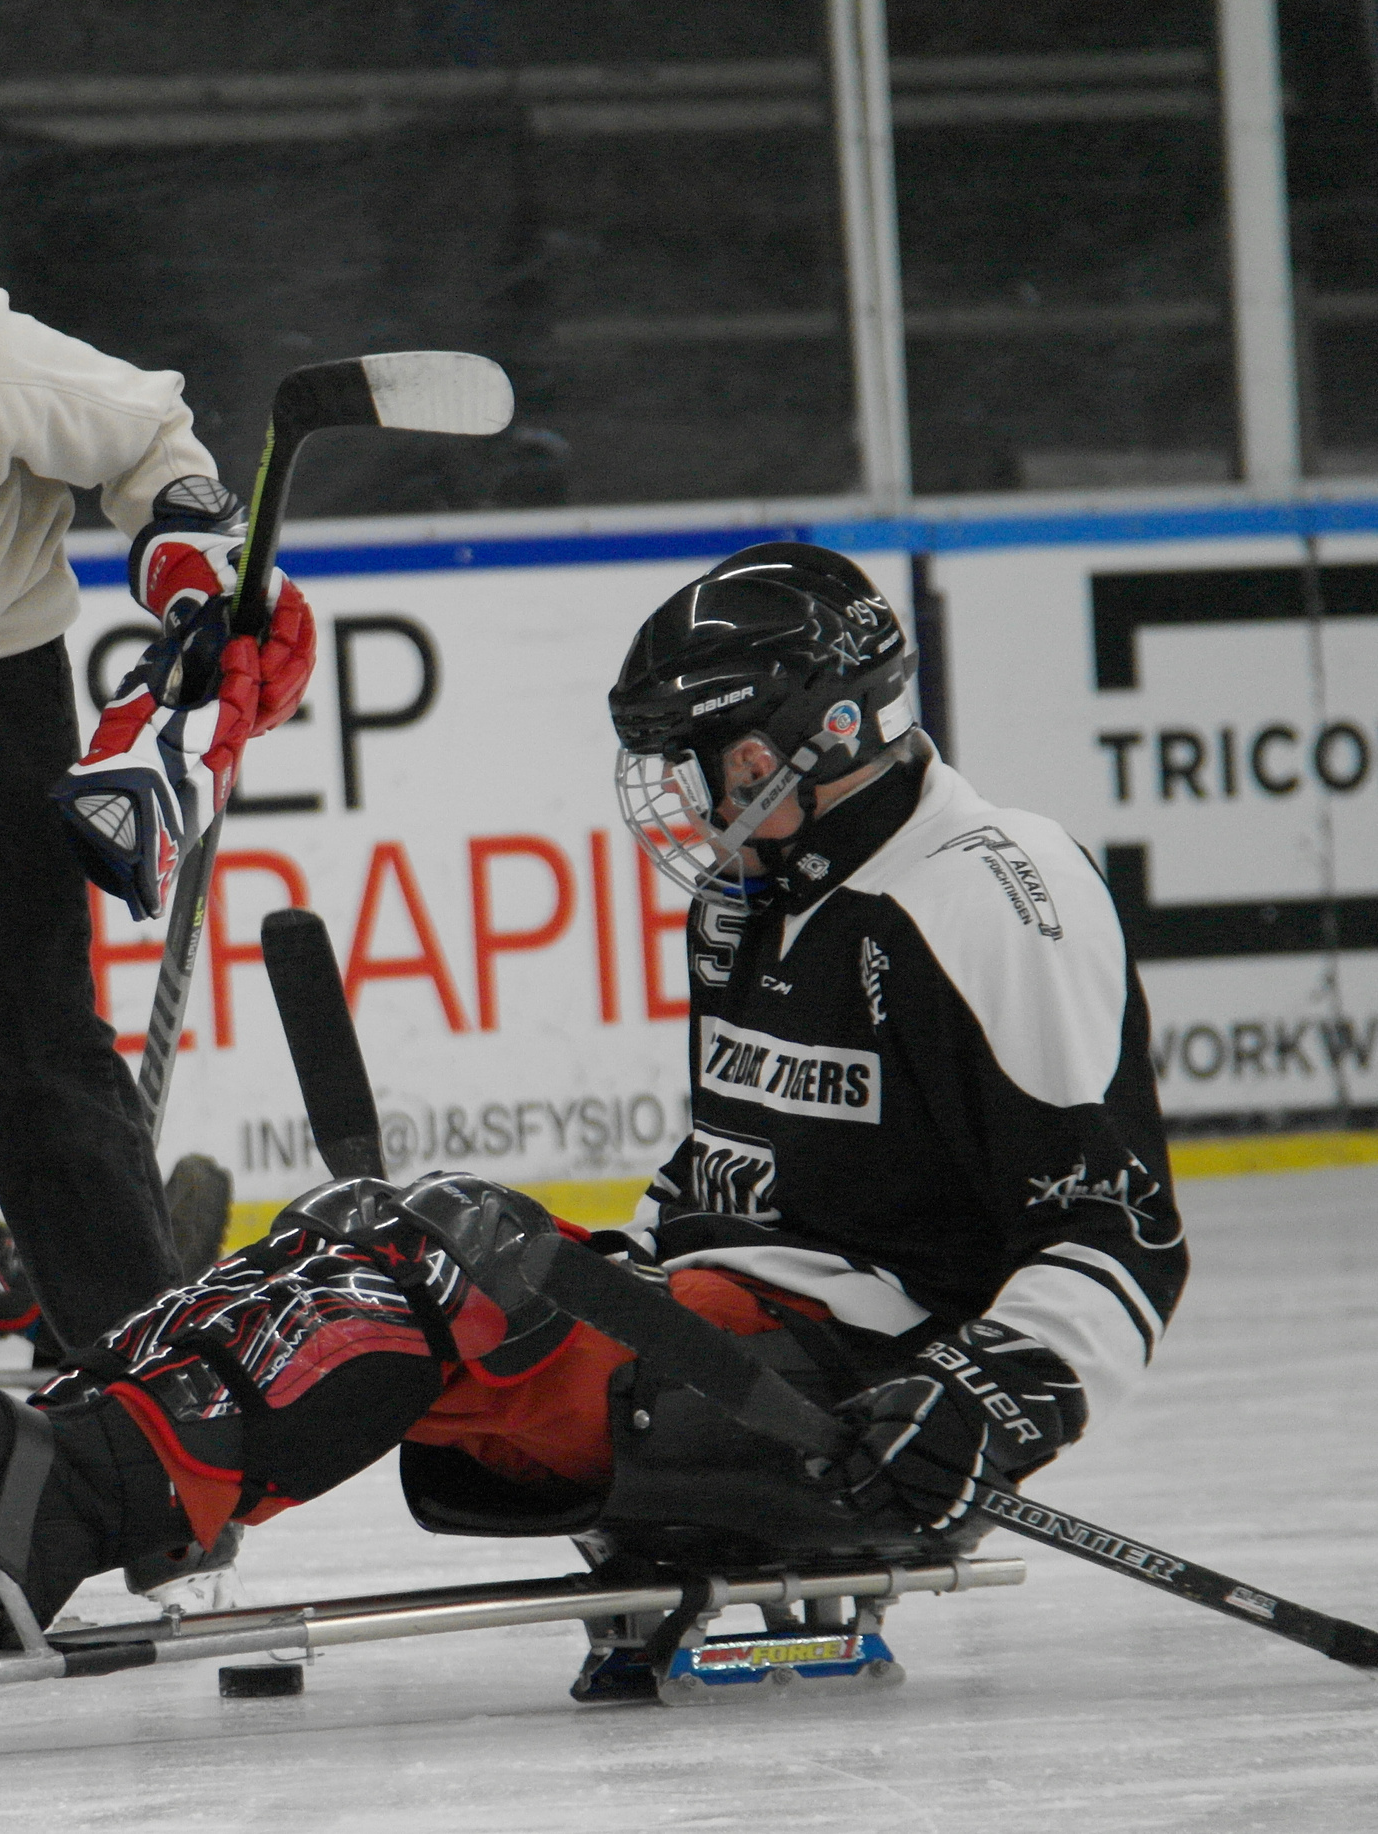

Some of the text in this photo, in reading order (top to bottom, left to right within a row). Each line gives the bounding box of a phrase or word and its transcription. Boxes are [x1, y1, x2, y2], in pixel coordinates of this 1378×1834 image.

[692, 685, 755, 718] BAUER
[760, 769, 795, 811] BAUE
[1097, 721, 1378, 804] TRICO
[981, 855, 1034, 926] AFDICHTINGEN
[1009, 859, 1048, 903] AKAR
[981, 1489, 1176, 1582] RONTIER
